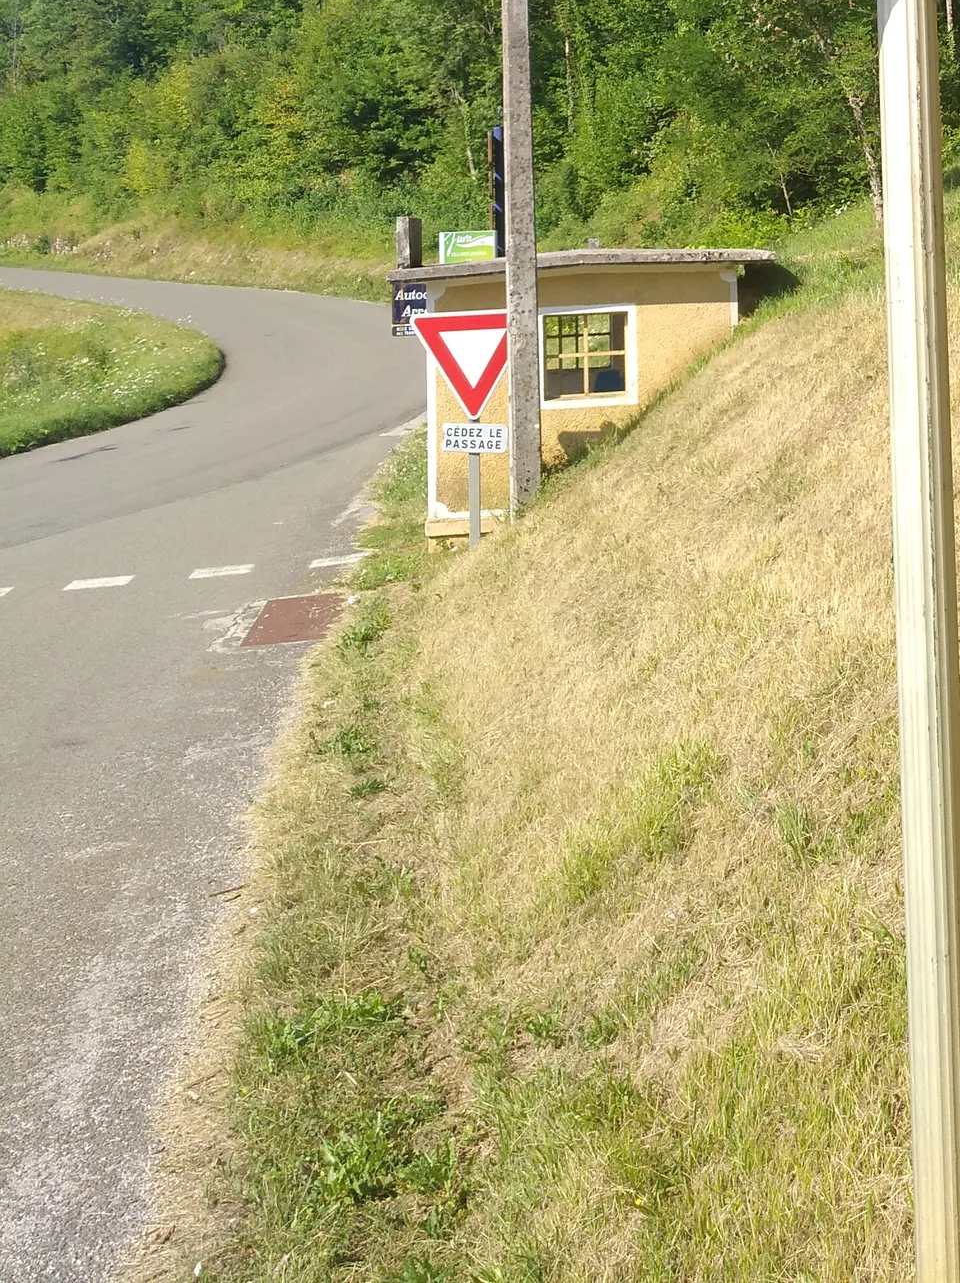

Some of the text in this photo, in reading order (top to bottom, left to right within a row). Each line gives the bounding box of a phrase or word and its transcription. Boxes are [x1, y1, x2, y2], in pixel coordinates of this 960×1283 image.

[446, 426, 502, 438] CÉDEZ LE
[445, 439, 501, 450] PASSAGE
